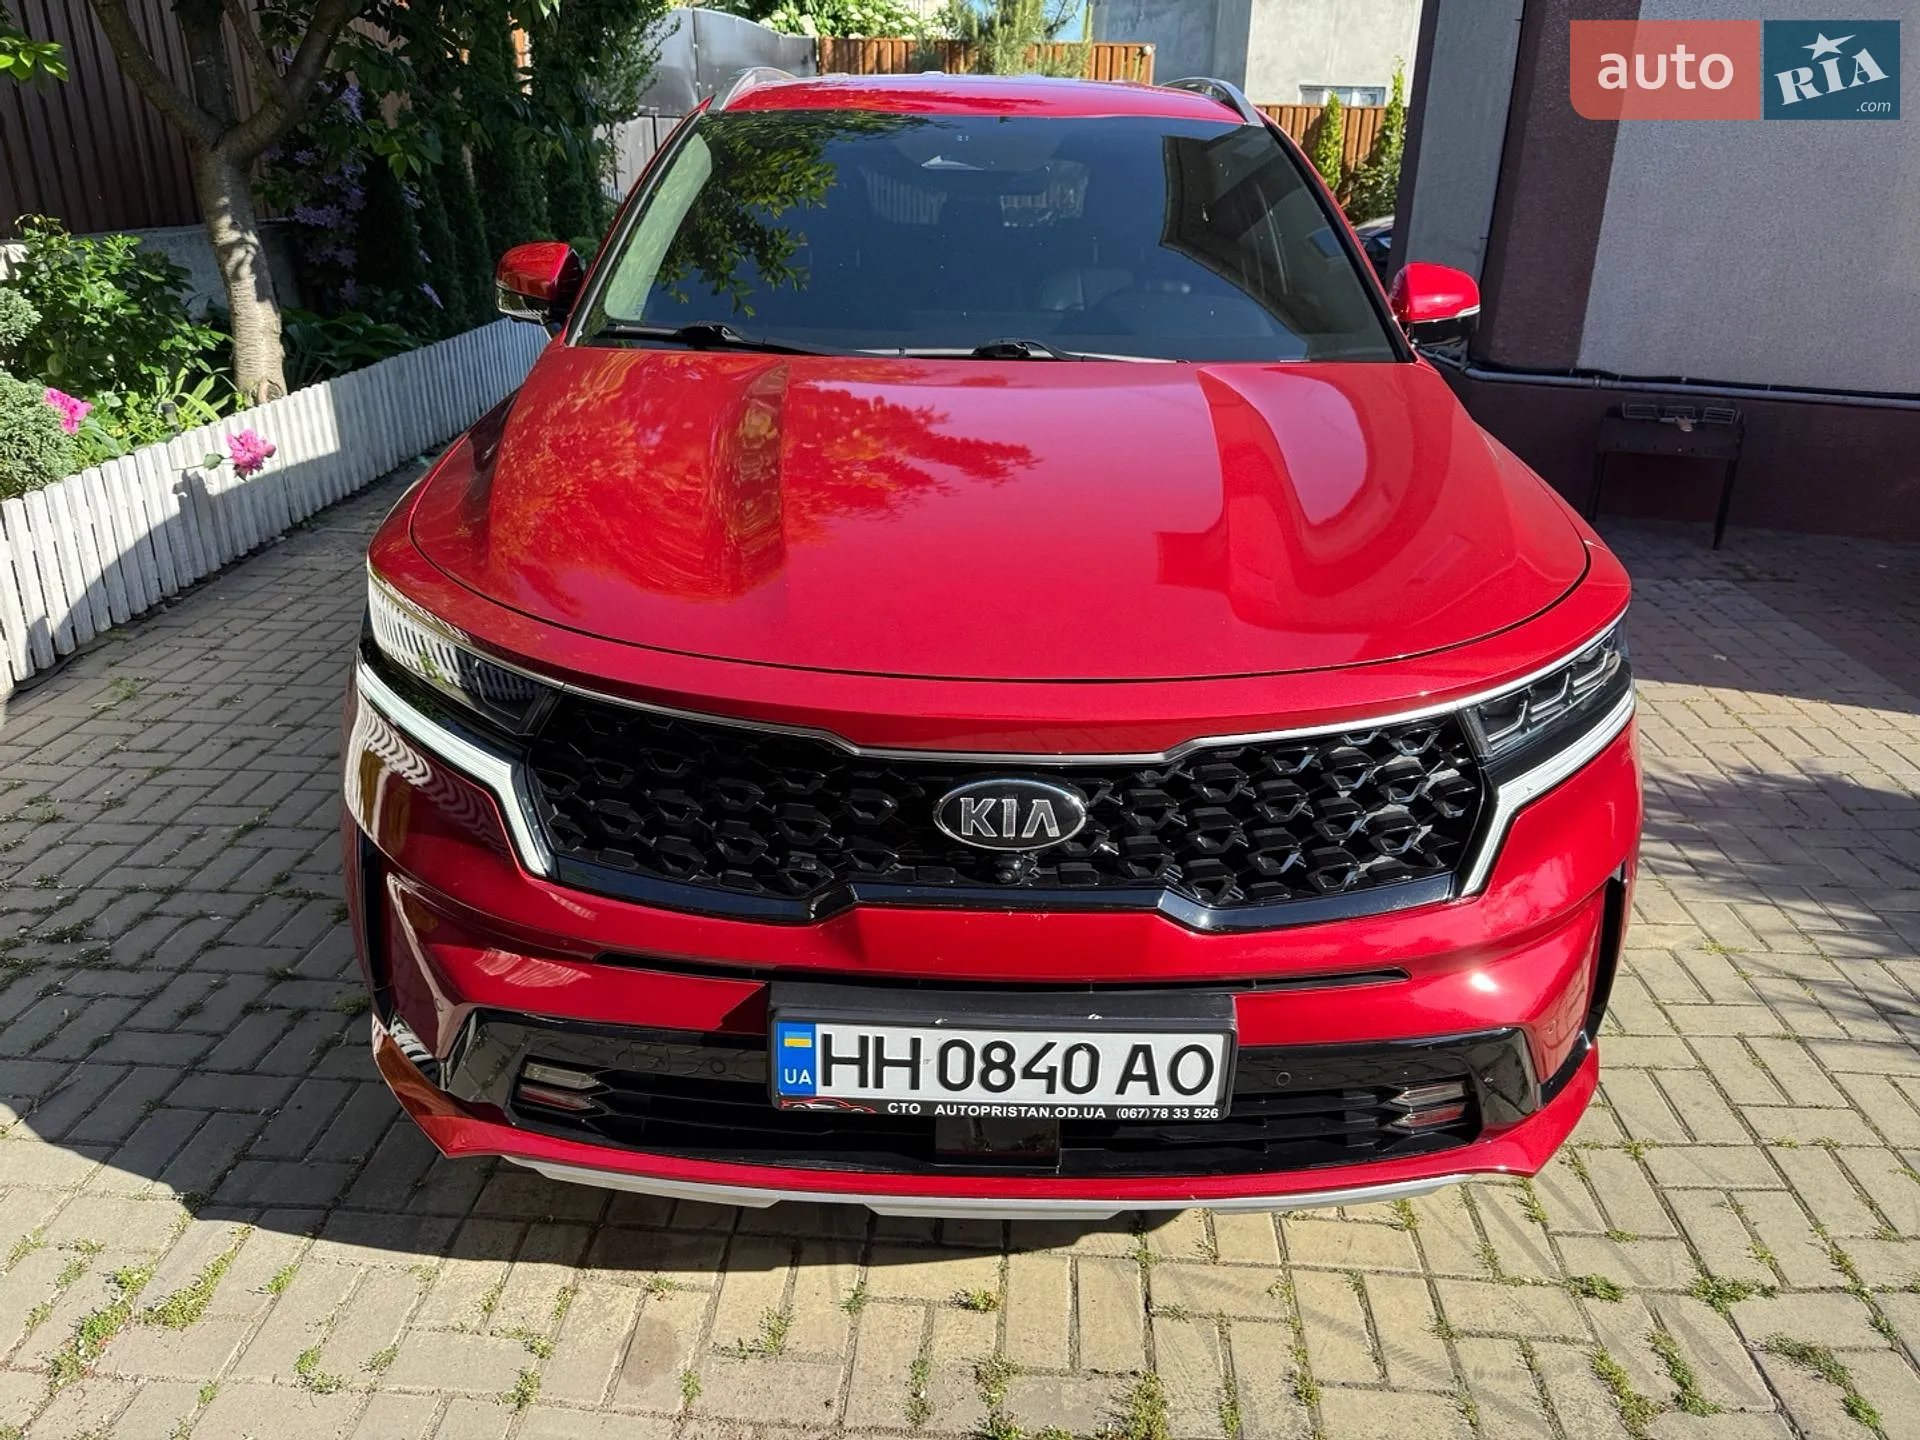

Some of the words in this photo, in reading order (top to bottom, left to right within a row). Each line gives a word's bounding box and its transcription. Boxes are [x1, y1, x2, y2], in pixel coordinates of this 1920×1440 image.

[959, 797, 1061, 838] KIA
[784, 1071, 812, 1086] UA
[821, 1033, 922, 1090] HH
[937, 1038, 1100, 1095] 0840
[1114, 1043, 1214, 1096] AO
[934, 1103, 1106, 1118] AUTOPRISTAN.OD.UA
[1116, 1108, 1150, 1120] (067)
[1153, 1108, 1170, 1119] 78
[1173, 1108, 1190, 1119] 33
[1194, 1108, 1219, 1119] 526
